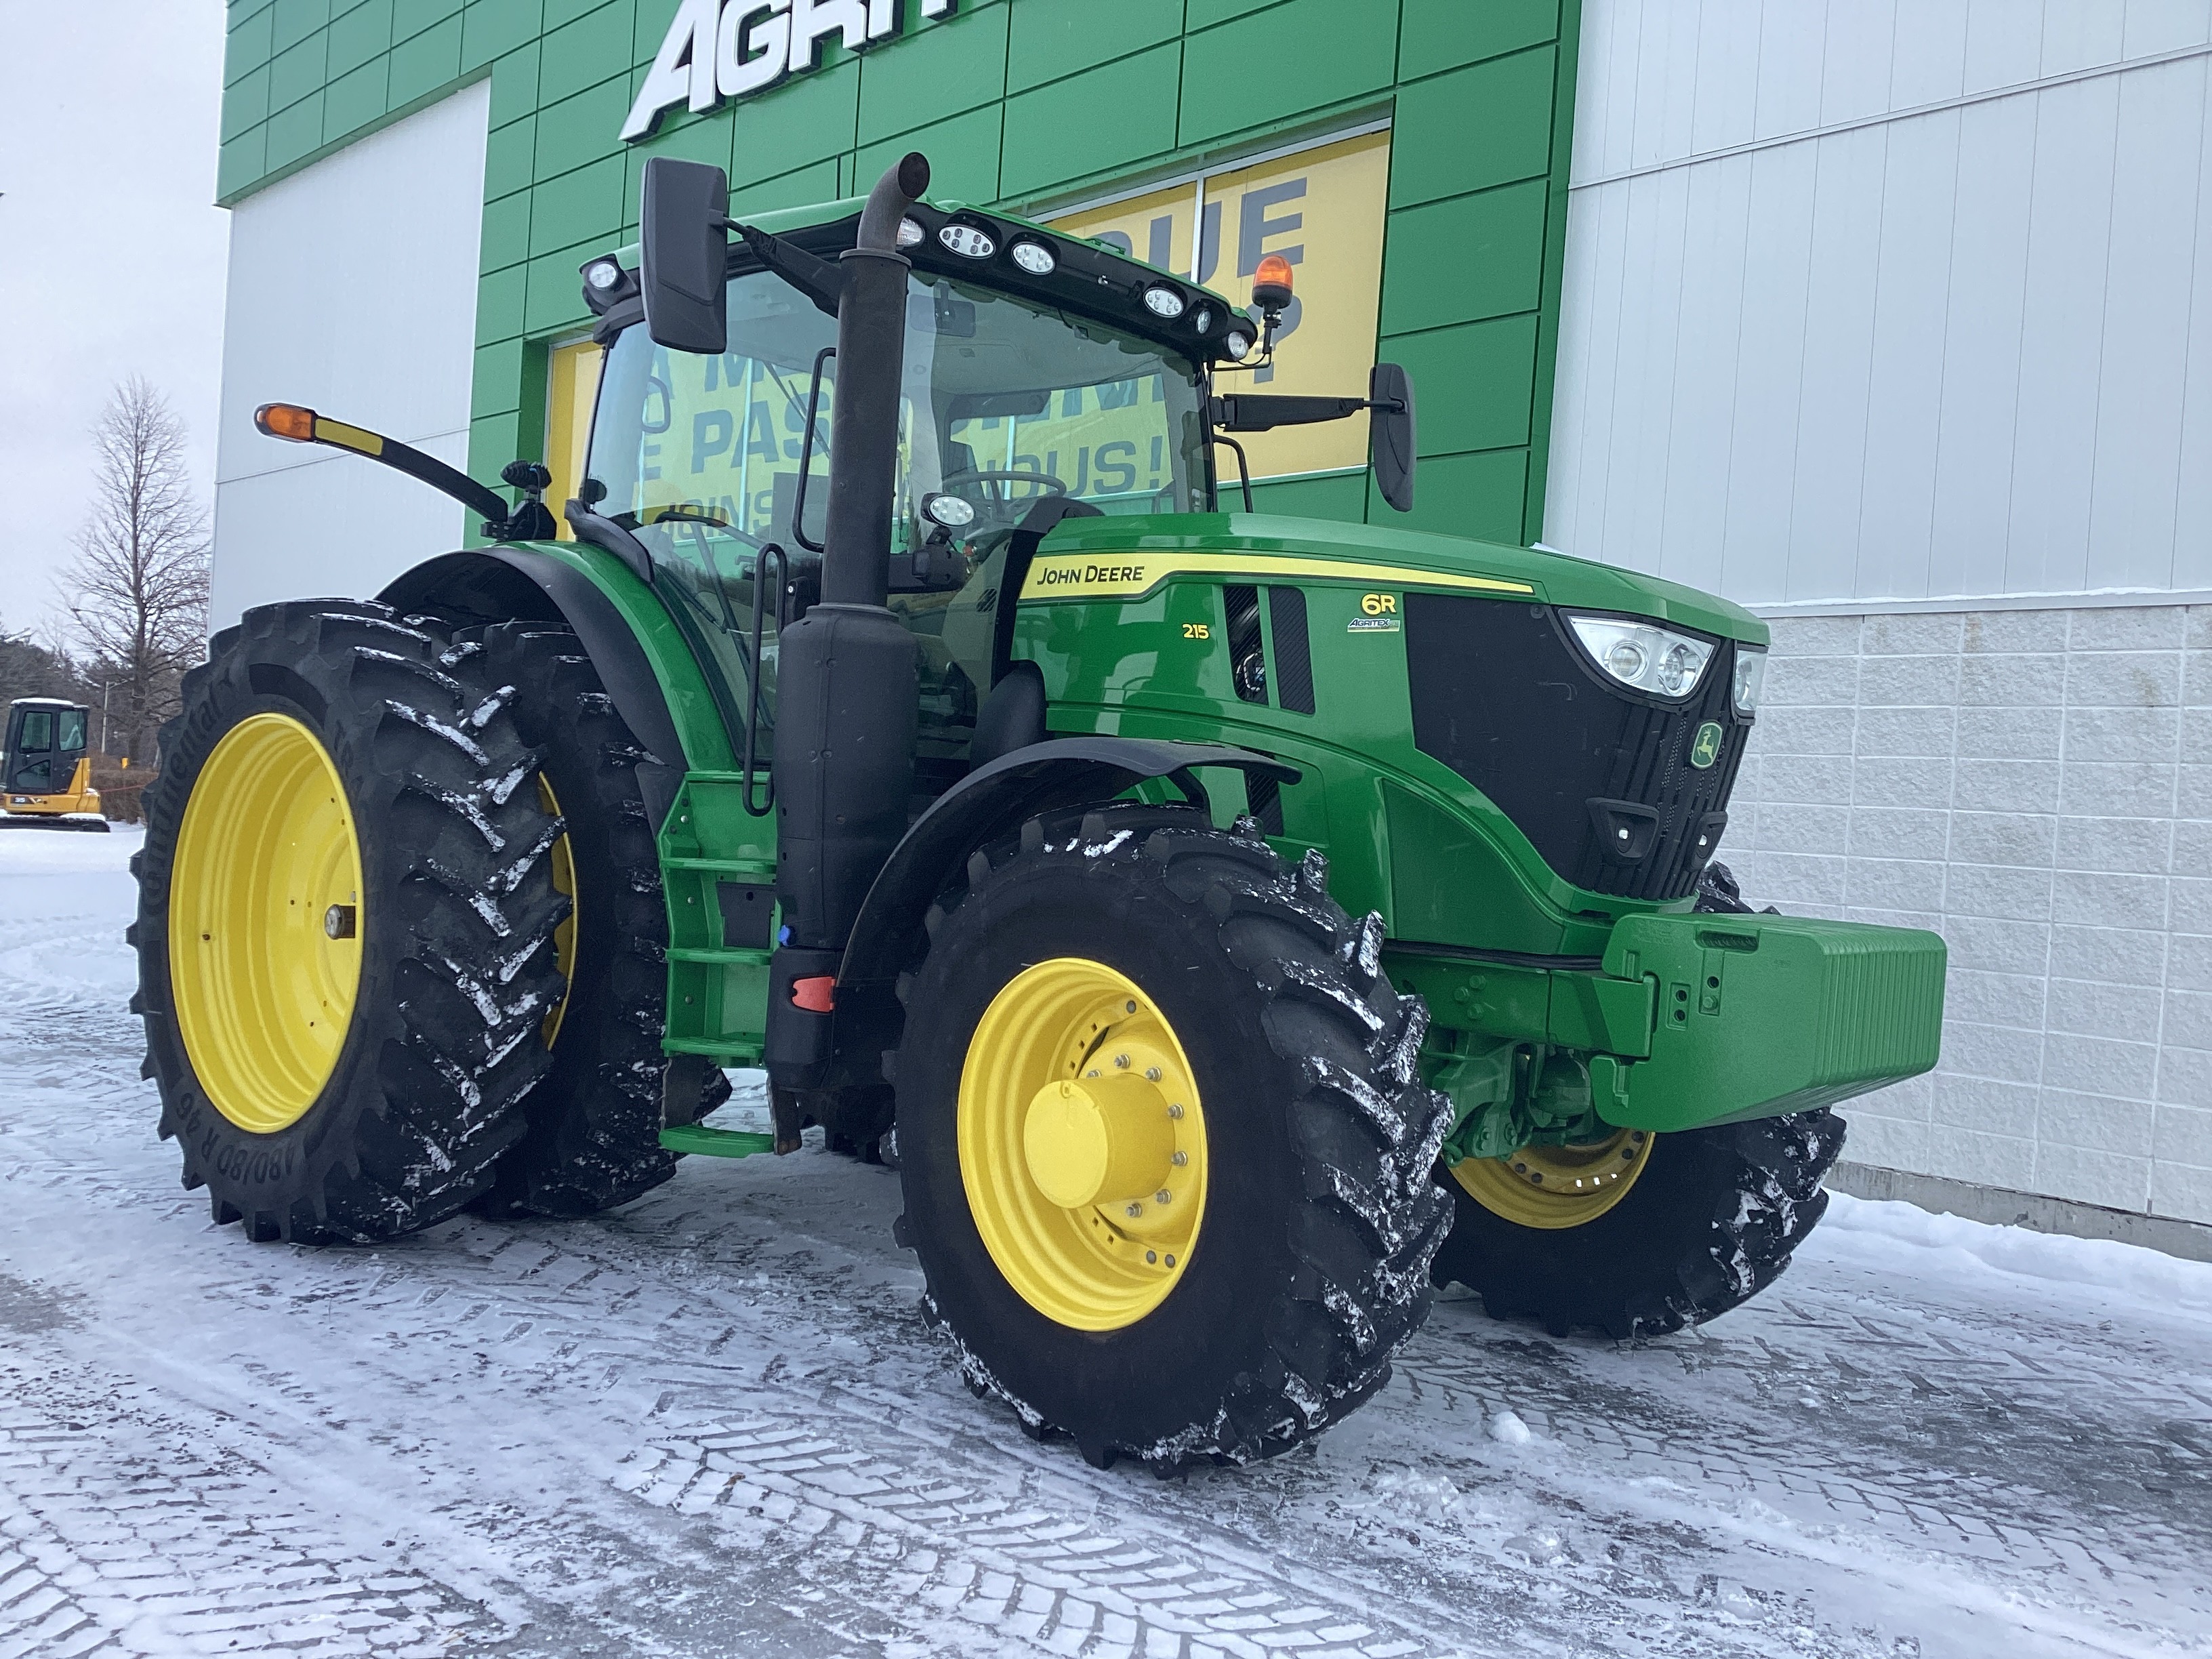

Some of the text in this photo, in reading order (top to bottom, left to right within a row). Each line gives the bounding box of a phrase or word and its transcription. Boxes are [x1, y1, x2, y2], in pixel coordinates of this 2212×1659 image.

[618, 0, 951, 141] AGR
[1037, 565, 1145, 585] JOHN DEERE
[1361, 593, 1397, 615] 6R
[1182, 623, 1209, 639] 215
[1349, 618, 1390, 627] AGRITEX
